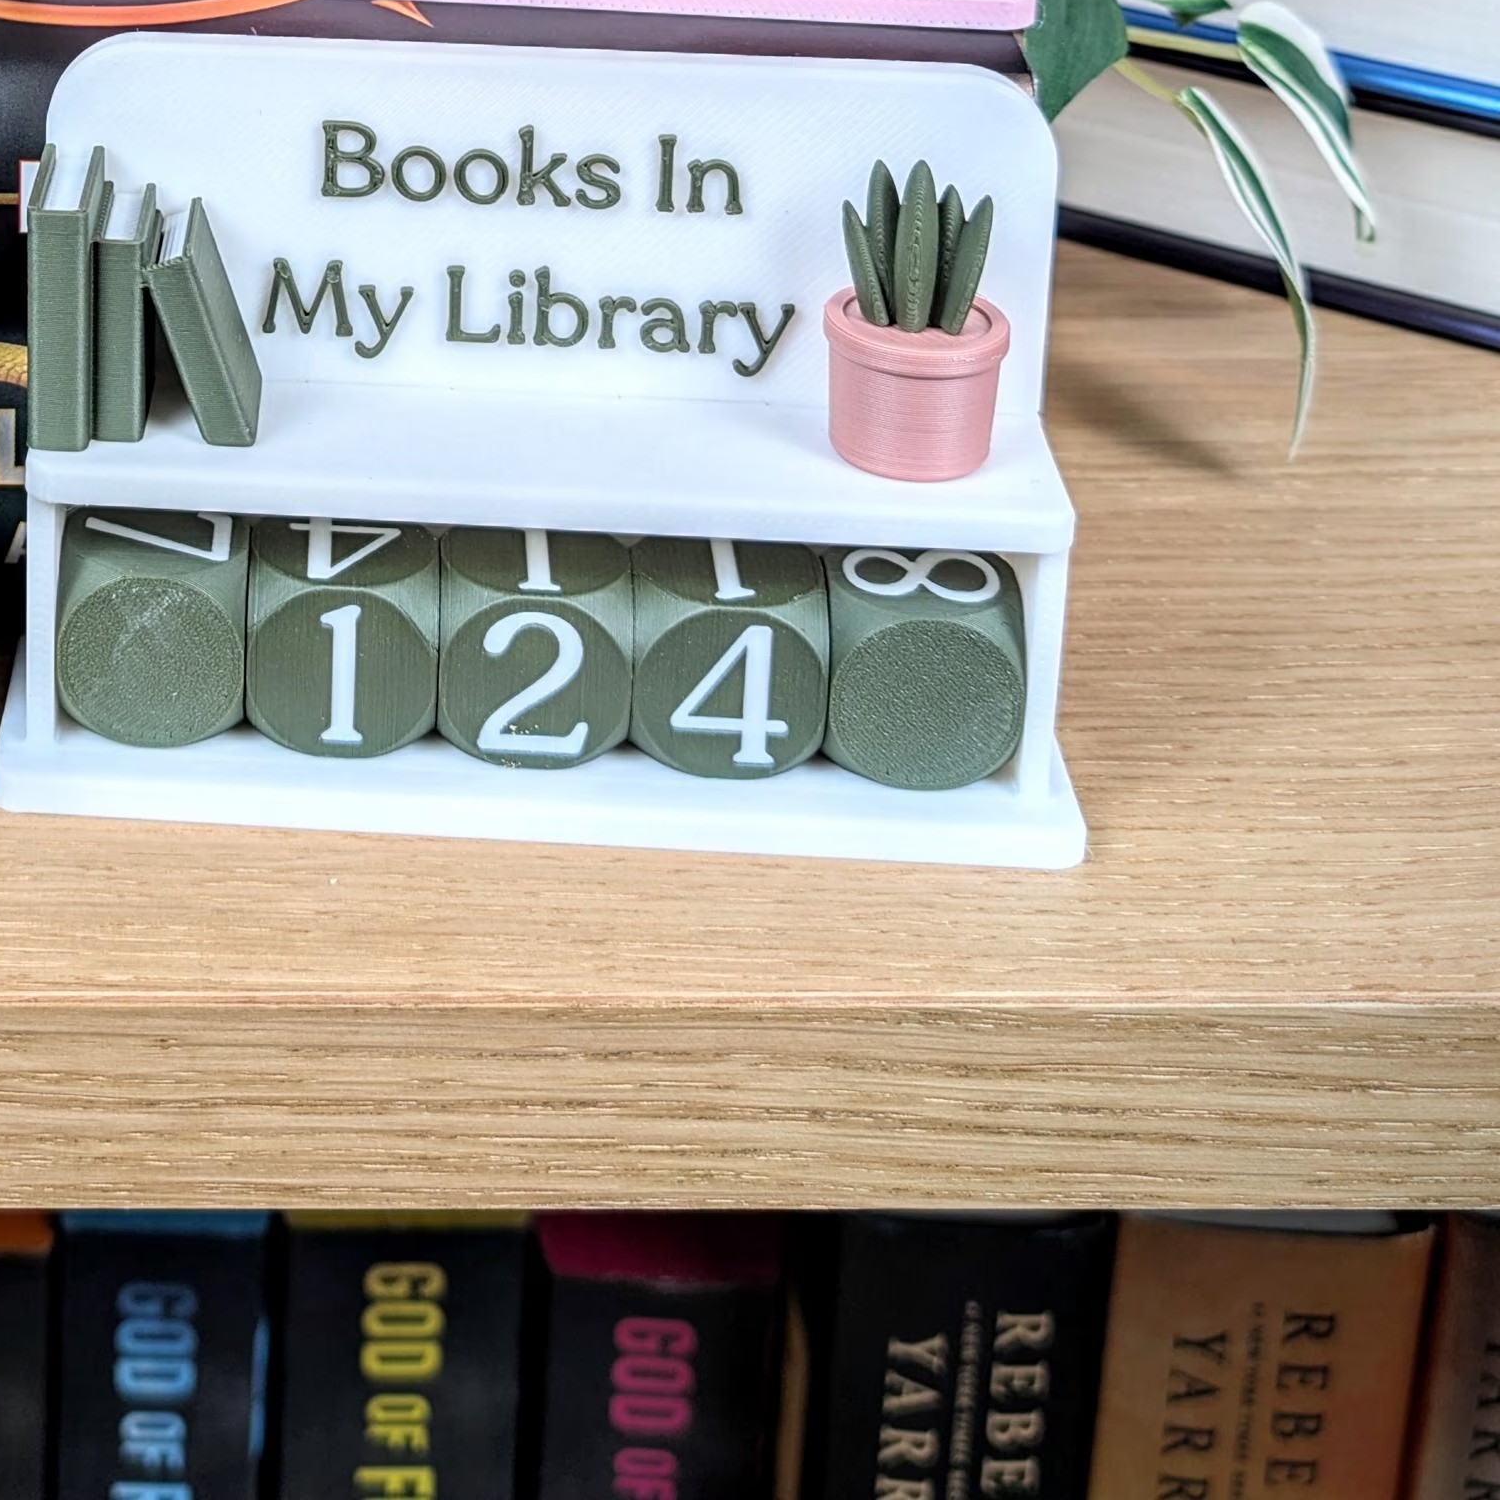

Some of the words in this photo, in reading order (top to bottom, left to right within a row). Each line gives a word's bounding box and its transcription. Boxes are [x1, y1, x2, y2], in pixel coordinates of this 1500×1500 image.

[322, 120, 621, 210] Books
[655, 133, 743, 215] In
[262, 257, 414, 359] My
[445, 264, 796, 378] Library
[112, 1282, 198, 1404] GOD
[359, 1261, 446, 1380] GOD
[607, 1315, 699, 1436] GOD
[118, 1411, 187, 1475] OF
[364, 1393, 432, 1453] OF
[980, 1310, 1055, 1497] REBE
[1264, 1308, 1337, 1486] REBE
[610, 1446, 679, 1500] OF
